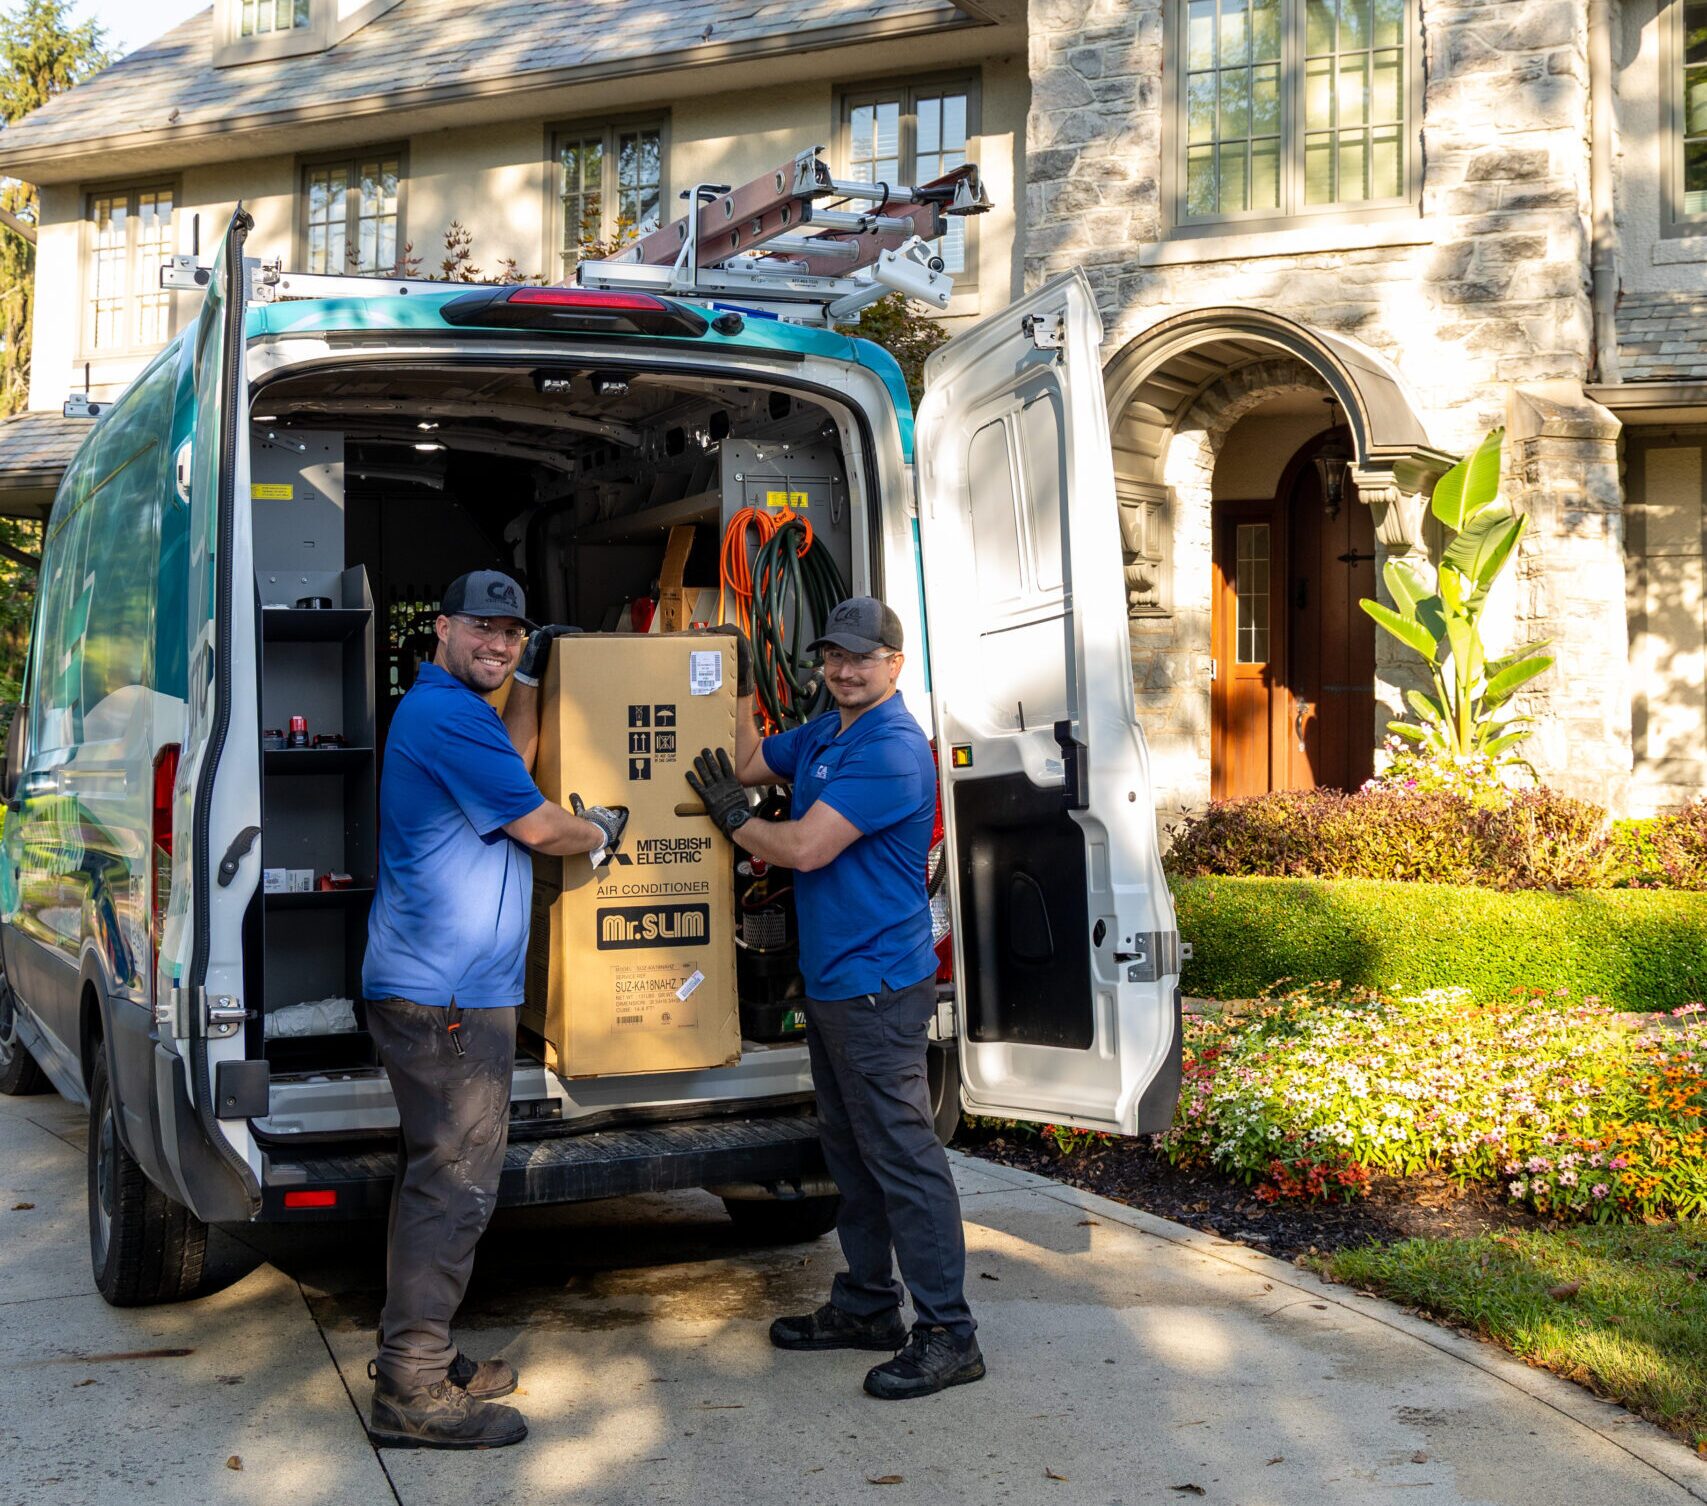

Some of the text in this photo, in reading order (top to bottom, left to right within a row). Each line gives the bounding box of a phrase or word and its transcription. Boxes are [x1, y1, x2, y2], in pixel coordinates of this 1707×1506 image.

[637, 837, 711, 852] MITSUBISHI
[637, 850, 702, 865] ELECTRIC
[597, 881, 709, 896] AIR CONDITIONER
